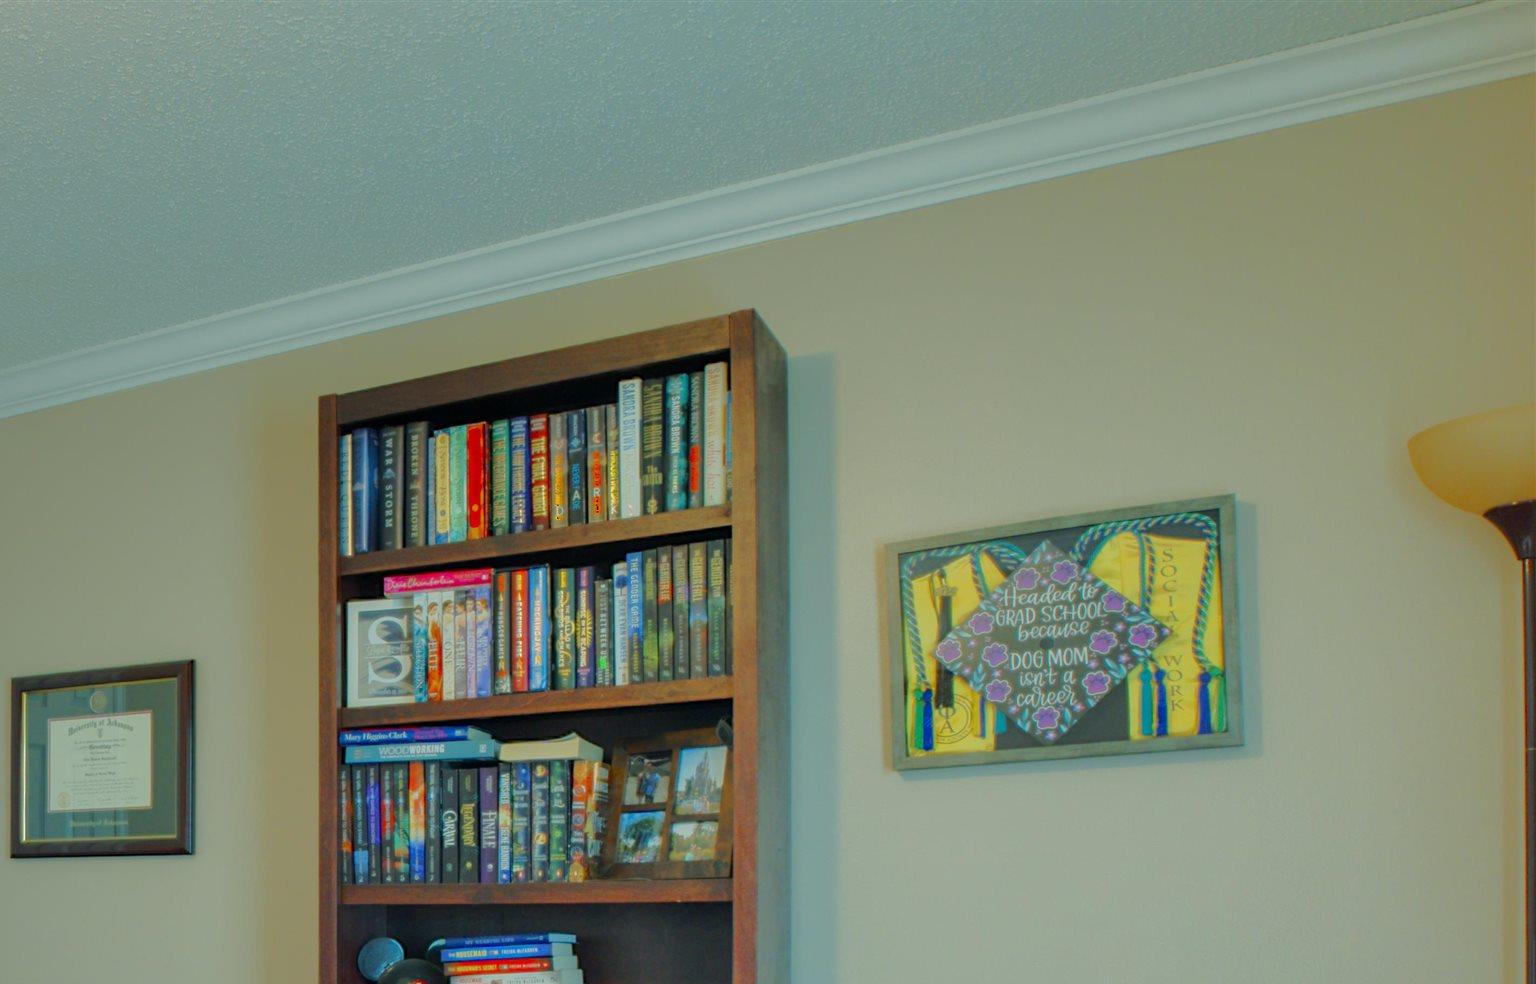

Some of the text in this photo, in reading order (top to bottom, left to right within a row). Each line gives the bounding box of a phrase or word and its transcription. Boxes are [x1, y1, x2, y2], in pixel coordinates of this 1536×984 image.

[622, 383, 636, 452] SANDRA BROWN
[644, 384, 662, 422] SANDRA
[644, 424, 662, 458] BROWN
[671, 395, 681, 453] SANDRA BROWN
[531, 436, 547, 454] THE
[384, 438, 393, 528] WAR STORM
[410, 434, 419, 538] BROKEN THRONE
[630, 558, 638, 629] THE GENDER GAME
[1000, 582, 1097, 607] Headed to
[600, 613, 608, 648] BETWEEN
[995, 602, 1107, 627] GRAD SCHOOL
[1018, 621, 1089, 641] because
[1010, 646, 1088, 671] DOG MOM
[1020, 668, 1075, 686] isn't a
[1017, 685, 1078, 707] career
[344, 733, 362, 742] Mary
[362, 732, 388, 741] Higgins
[388, 730, 408, 739] Clark
[379, 744, 445, 755] WOODWORKING
[442, 809, 458, 849] CARAVAL
[460, 803, 476, 847] LEGENDARY
[482, 810, 497, 849] FINALE
